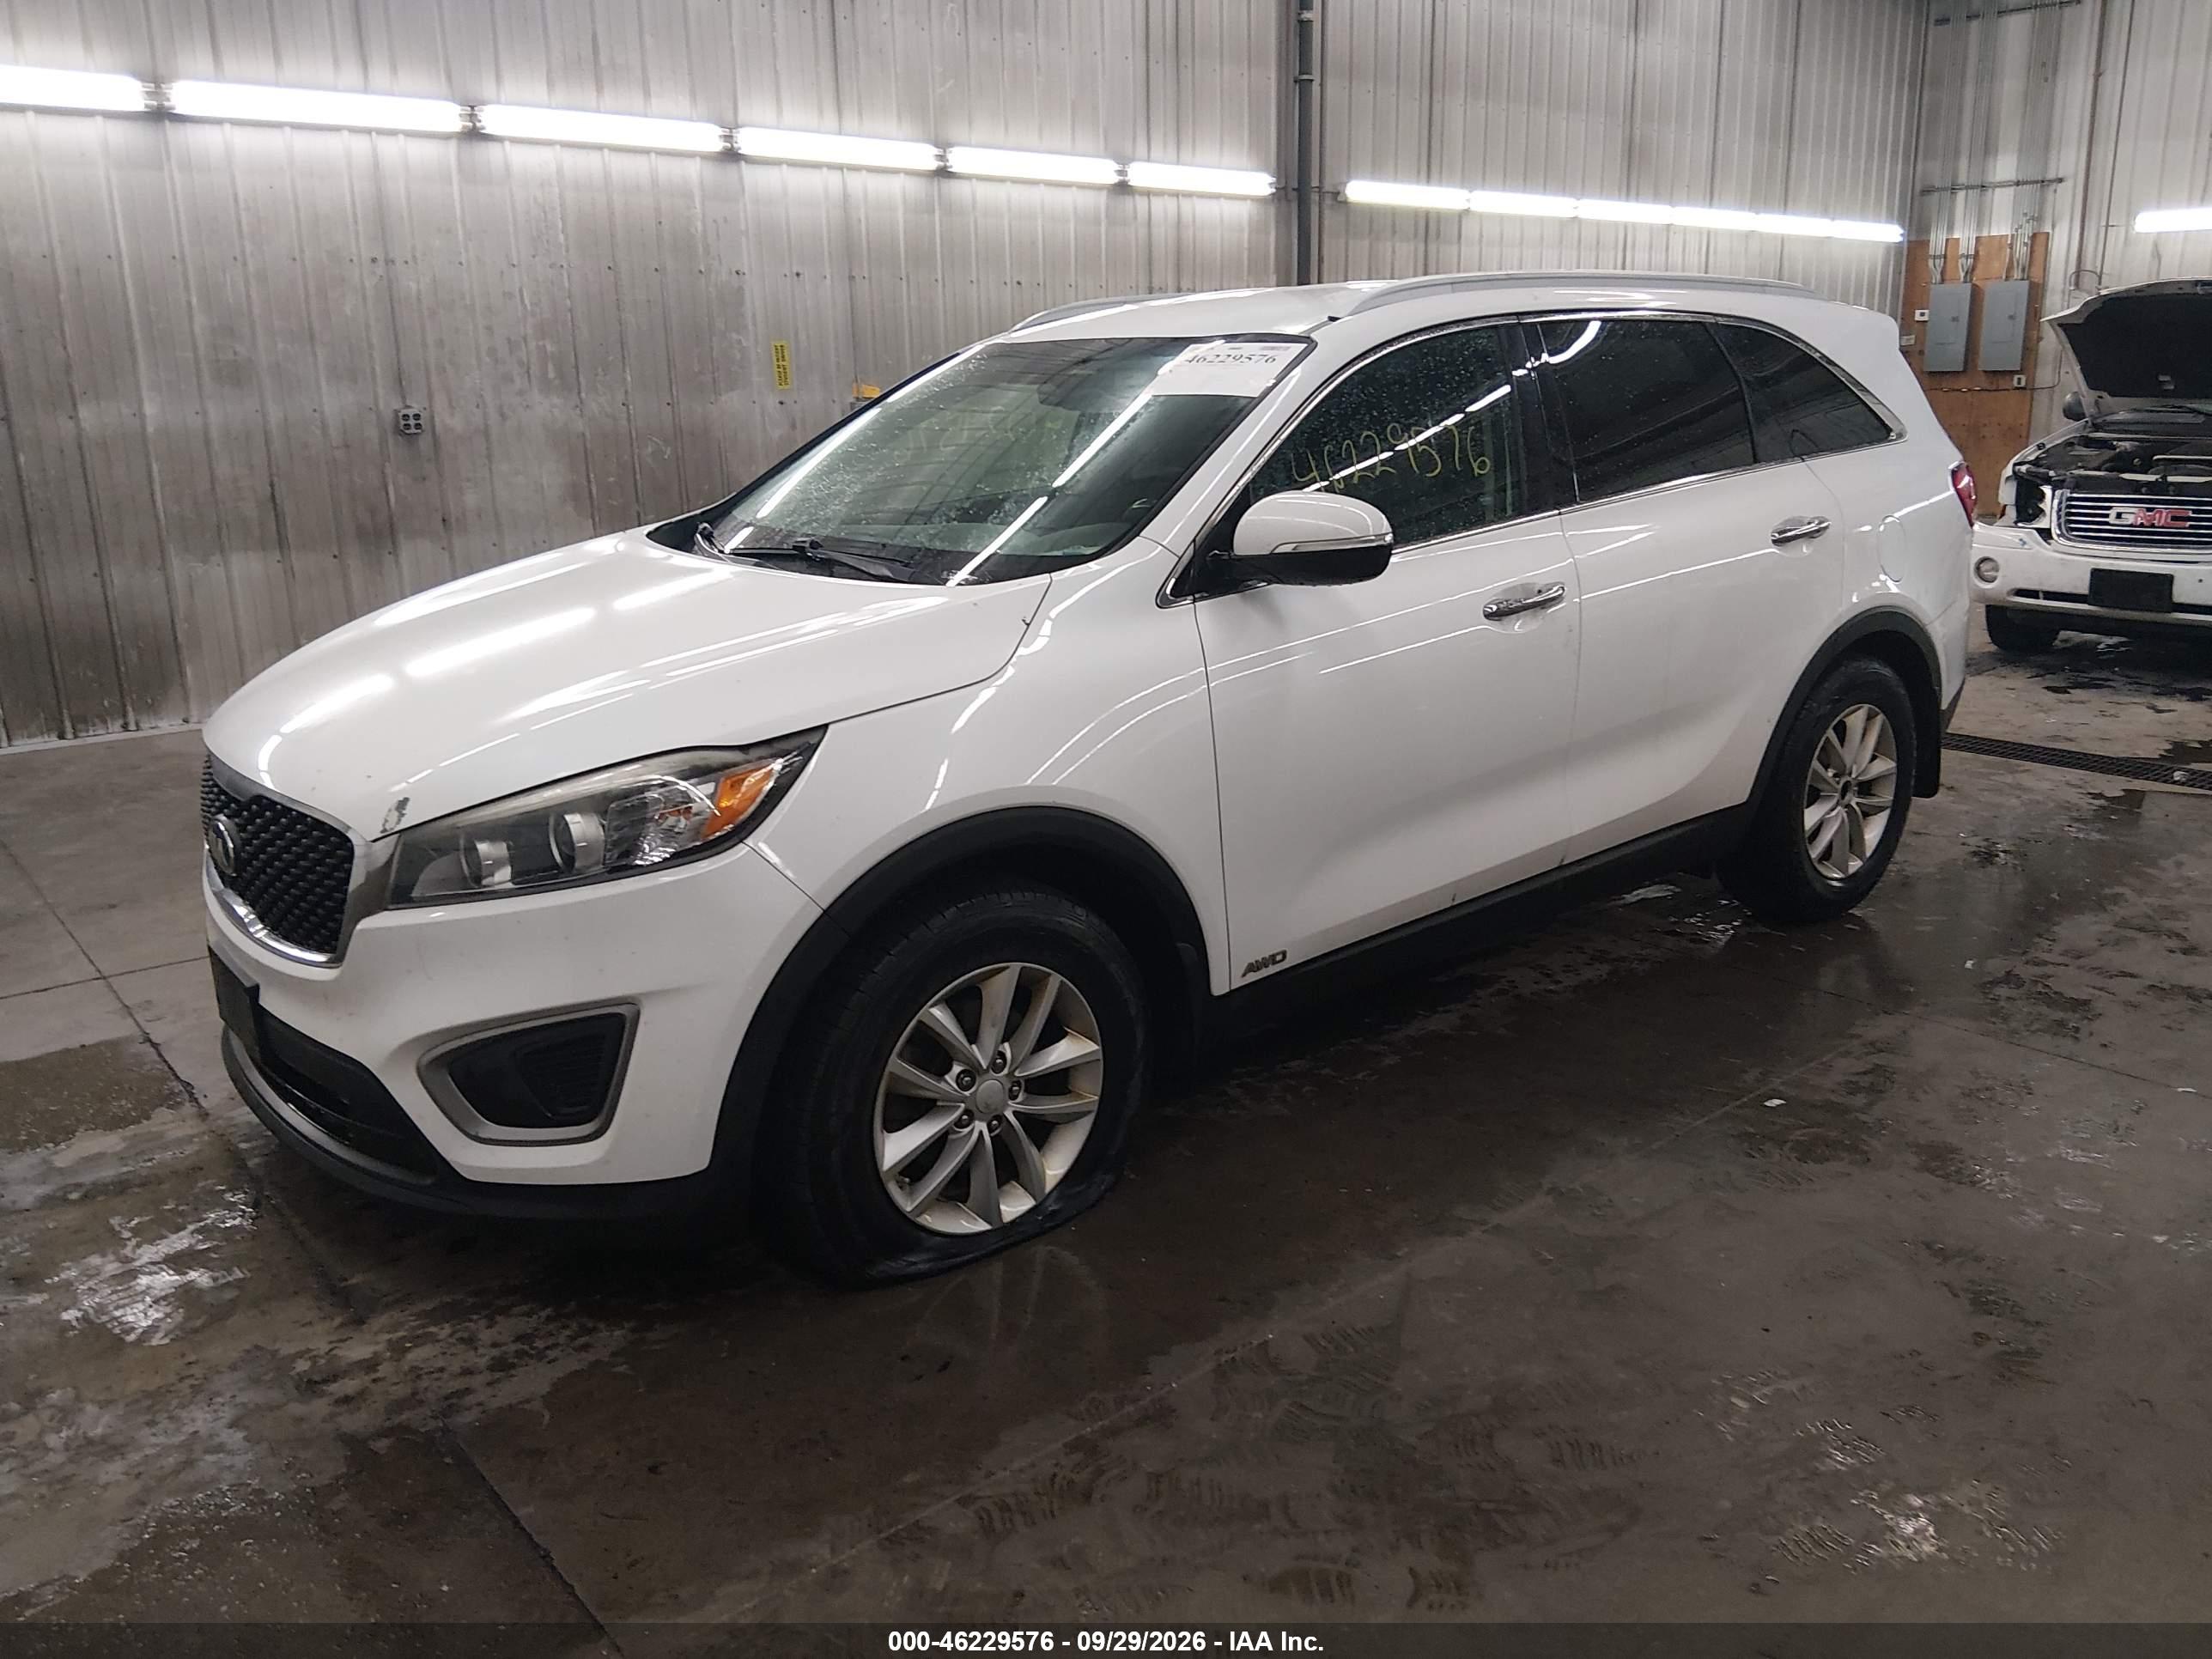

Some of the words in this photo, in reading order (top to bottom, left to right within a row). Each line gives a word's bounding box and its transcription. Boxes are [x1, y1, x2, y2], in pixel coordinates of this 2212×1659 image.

[1185, 354, 1277, 364] 46229576
[1291, 422, 1492, 493] 46229576
[2108, 507, 2193, 528] GMC
[1241, 949, 1288, 978] AWD
